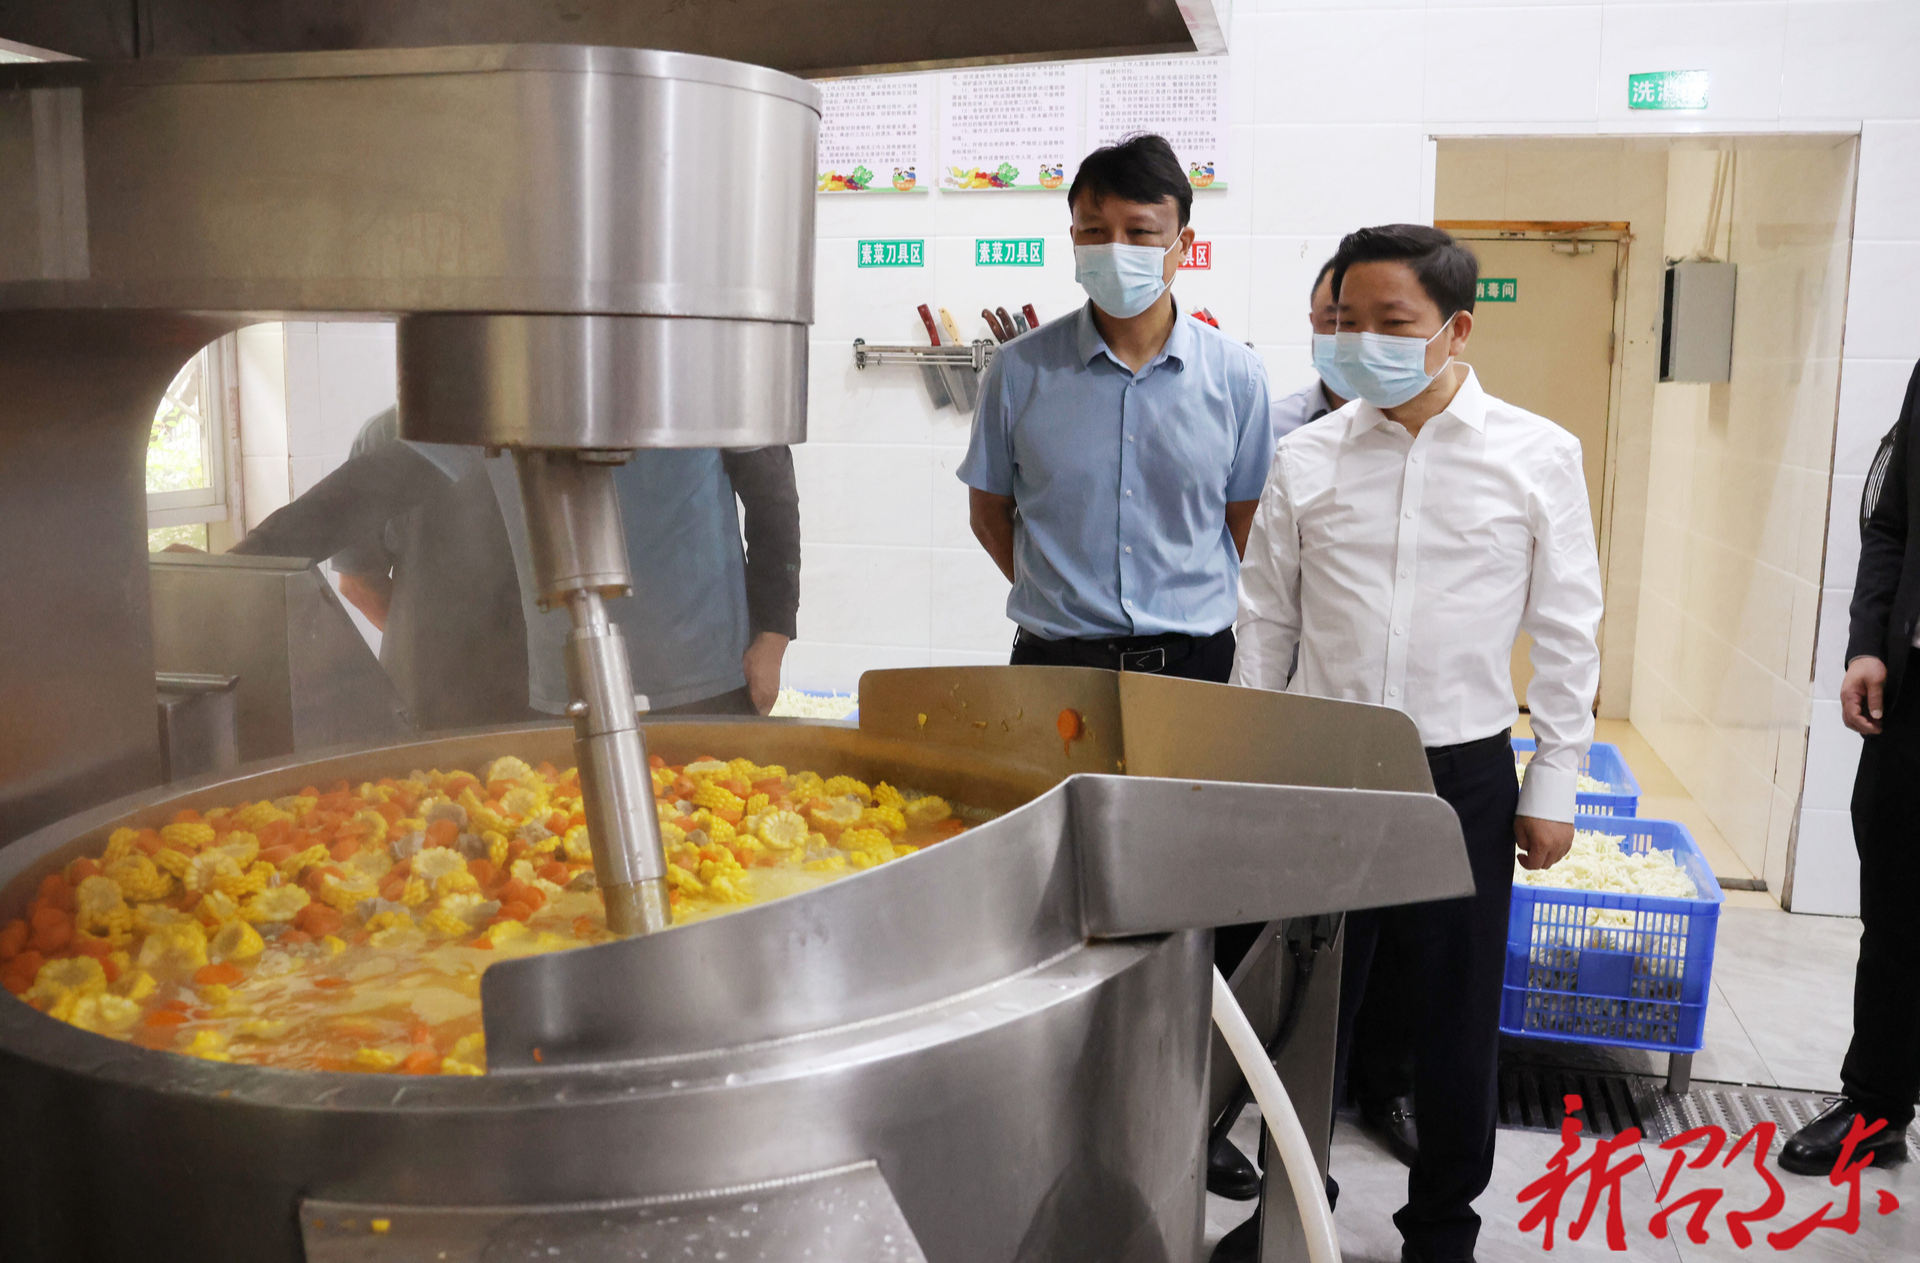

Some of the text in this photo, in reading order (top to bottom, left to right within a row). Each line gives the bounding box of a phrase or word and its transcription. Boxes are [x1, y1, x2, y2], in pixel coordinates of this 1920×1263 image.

[1633, 80, 1701, 103] 洗消
[861, 243, 921, 264] 素菜刀具区
[979, 242, 1041, 263] 素菜刀具区
